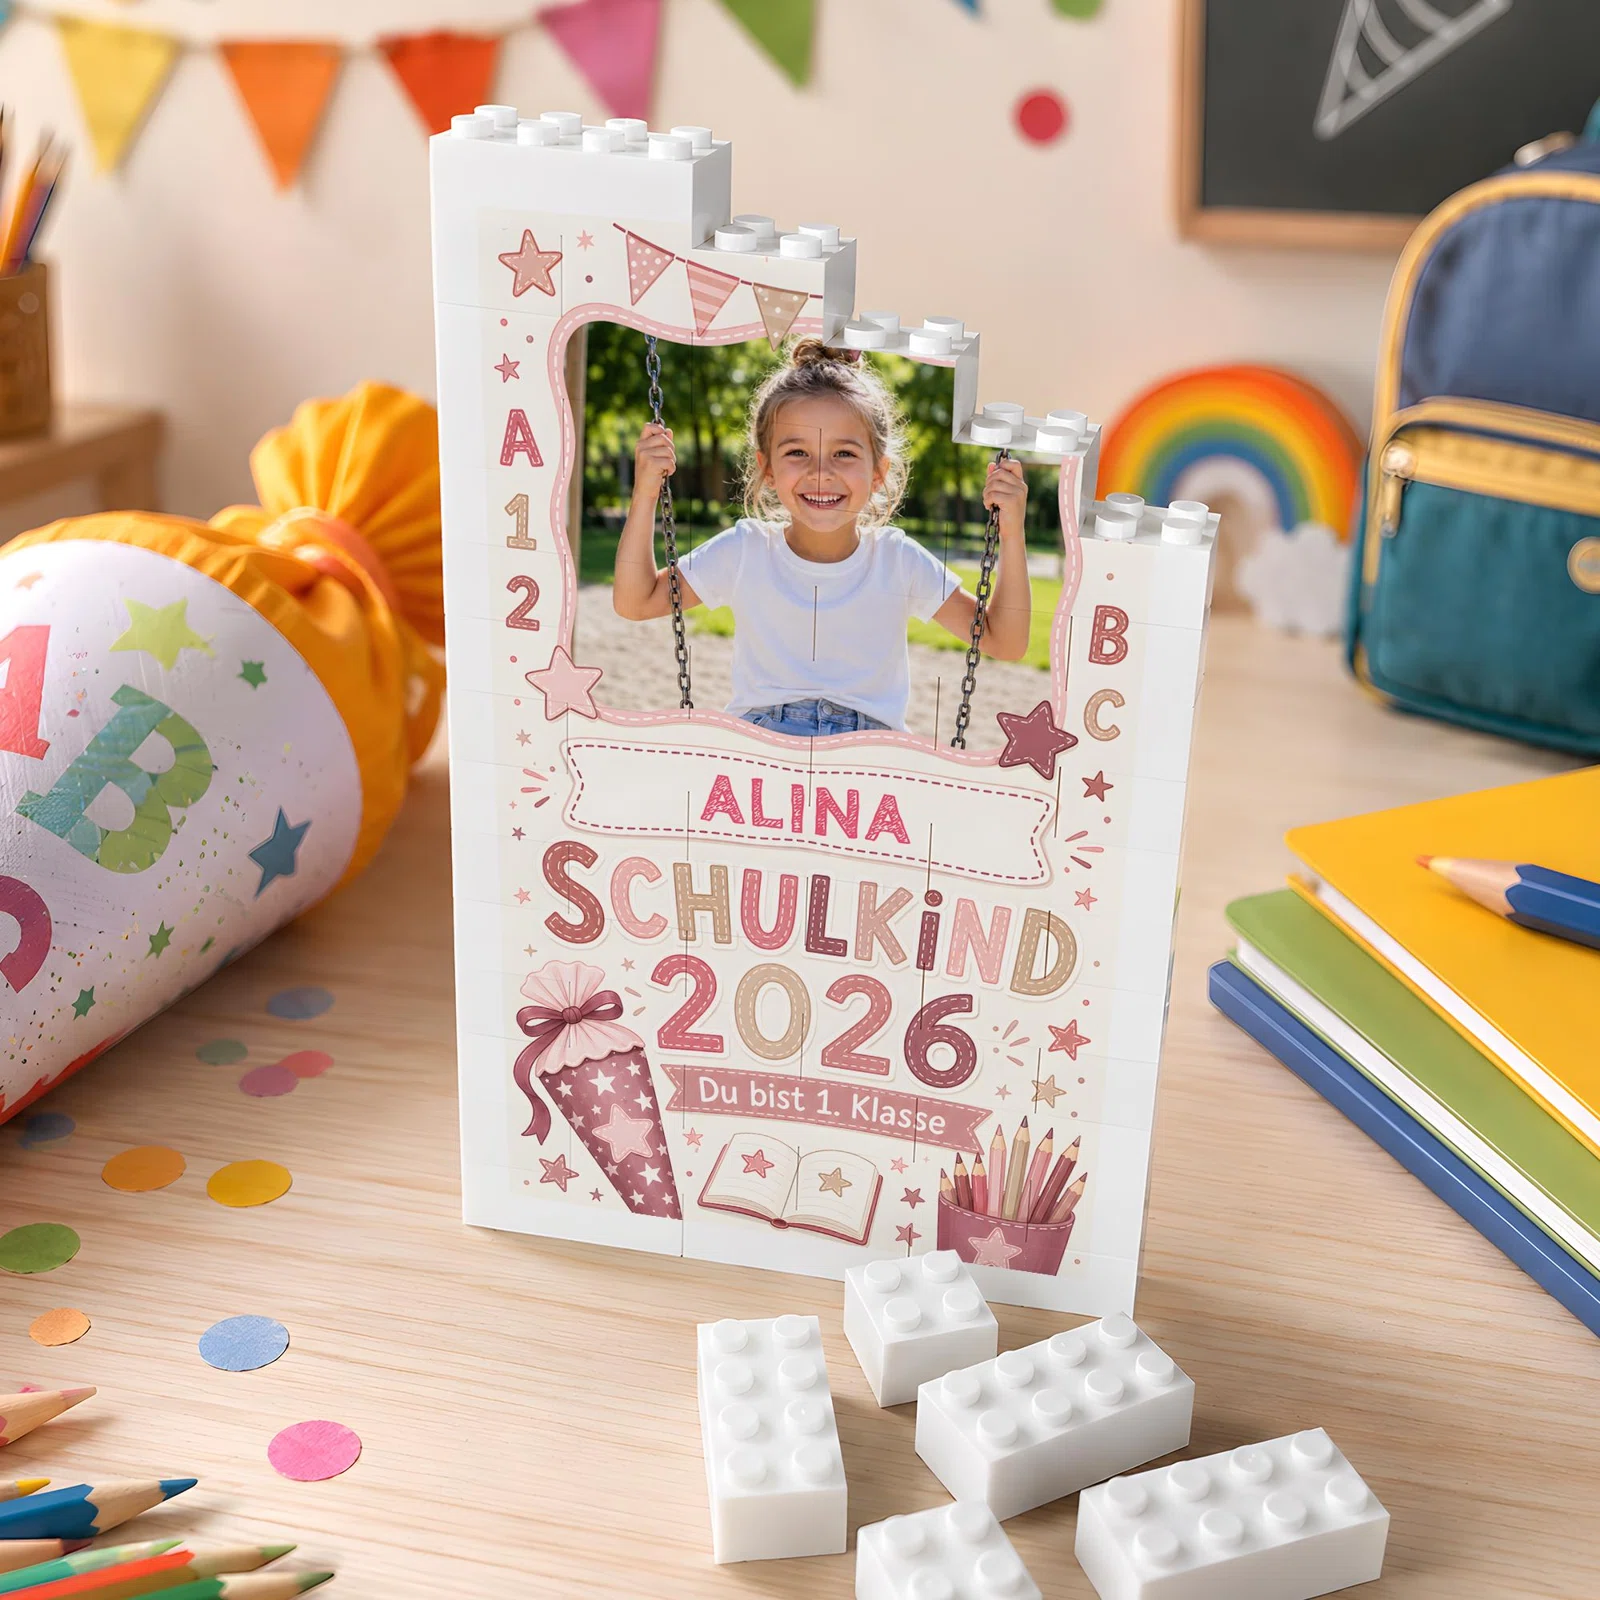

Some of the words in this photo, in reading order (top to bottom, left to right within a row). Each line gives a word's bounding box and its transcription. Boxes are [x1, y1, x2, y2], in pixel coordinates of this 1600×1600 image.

[15, 684, 213, 874] B
[701, 774, 910, 844] ALINA
[650, 953, 978, 1089] 2026
[699, 1076, 738, 1105] Du
[750, 1080, 805, 1112] bist
[816, 1089, 841, 1117] 1.
[851, 1093, 946, 1135] Klasse
